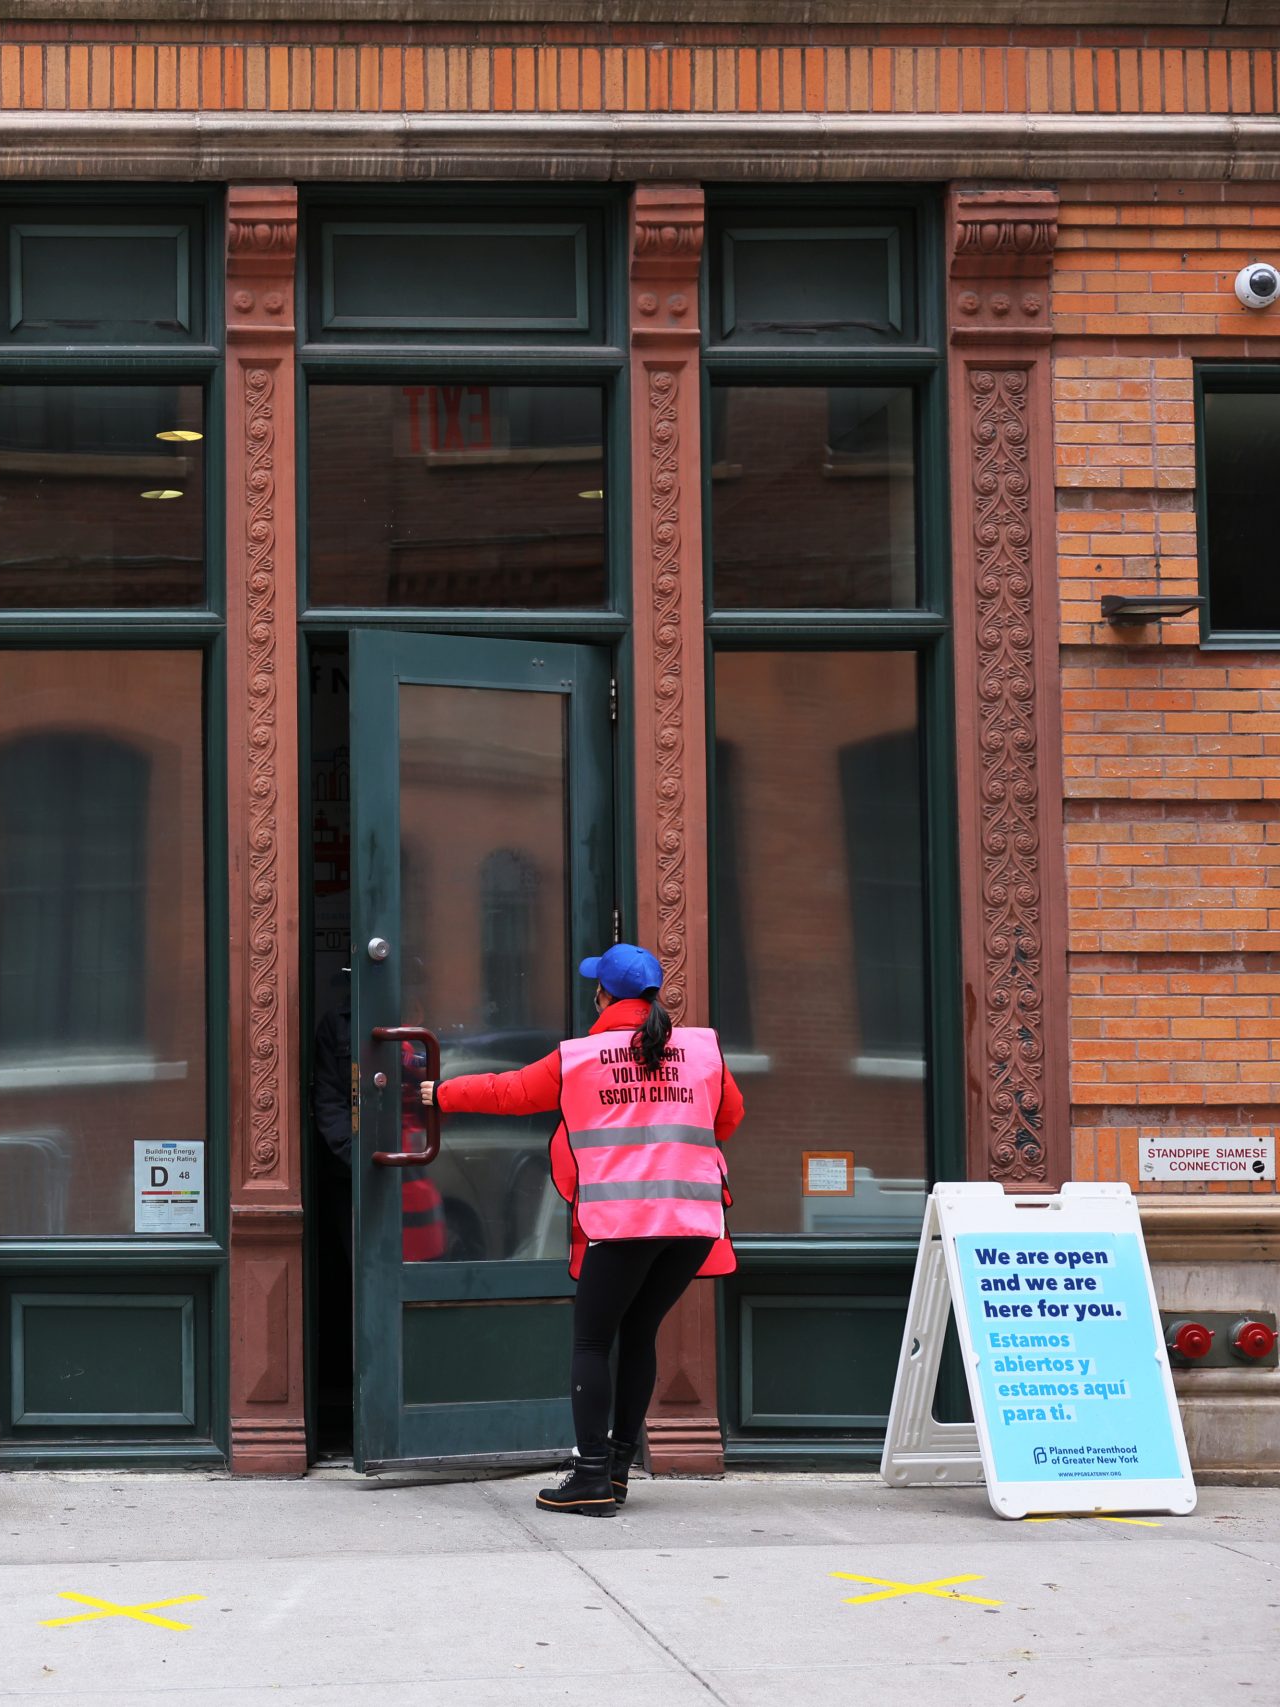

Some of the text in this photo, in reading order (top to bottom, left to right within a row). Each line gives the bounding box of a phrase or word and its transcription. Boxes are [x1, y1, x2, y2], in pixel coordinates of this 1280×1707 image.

[612, 1066, 679, 1084] VOLUNTEER
[599, 1086, 694, 1105] ESCOLTA CLINICA
[1147, 1148, 1268, 1159] STANDPIPE SIAMESE
[1169, 1161, 1247, 1172] CONNECTION
[151, 1166, 190, 1187] D 48
[975, 1248, 1109, 1269] We are open
[980, 1273, 1097, 1291] and we are
[983, 1299, 1122, 1322] here for you.
[989, 1332, 1070, 1348] Estamos
[994, 1355, 1090, 1376] abiertos y
[998, 1379, 1126, 1400] estamos aquí
[1002, 1403, 1072, 1426] para ti.
[1049, 1445, 1138, 1455] Planned Parenthood
[1051, 1455, 1139, 1465] of Greater New York
